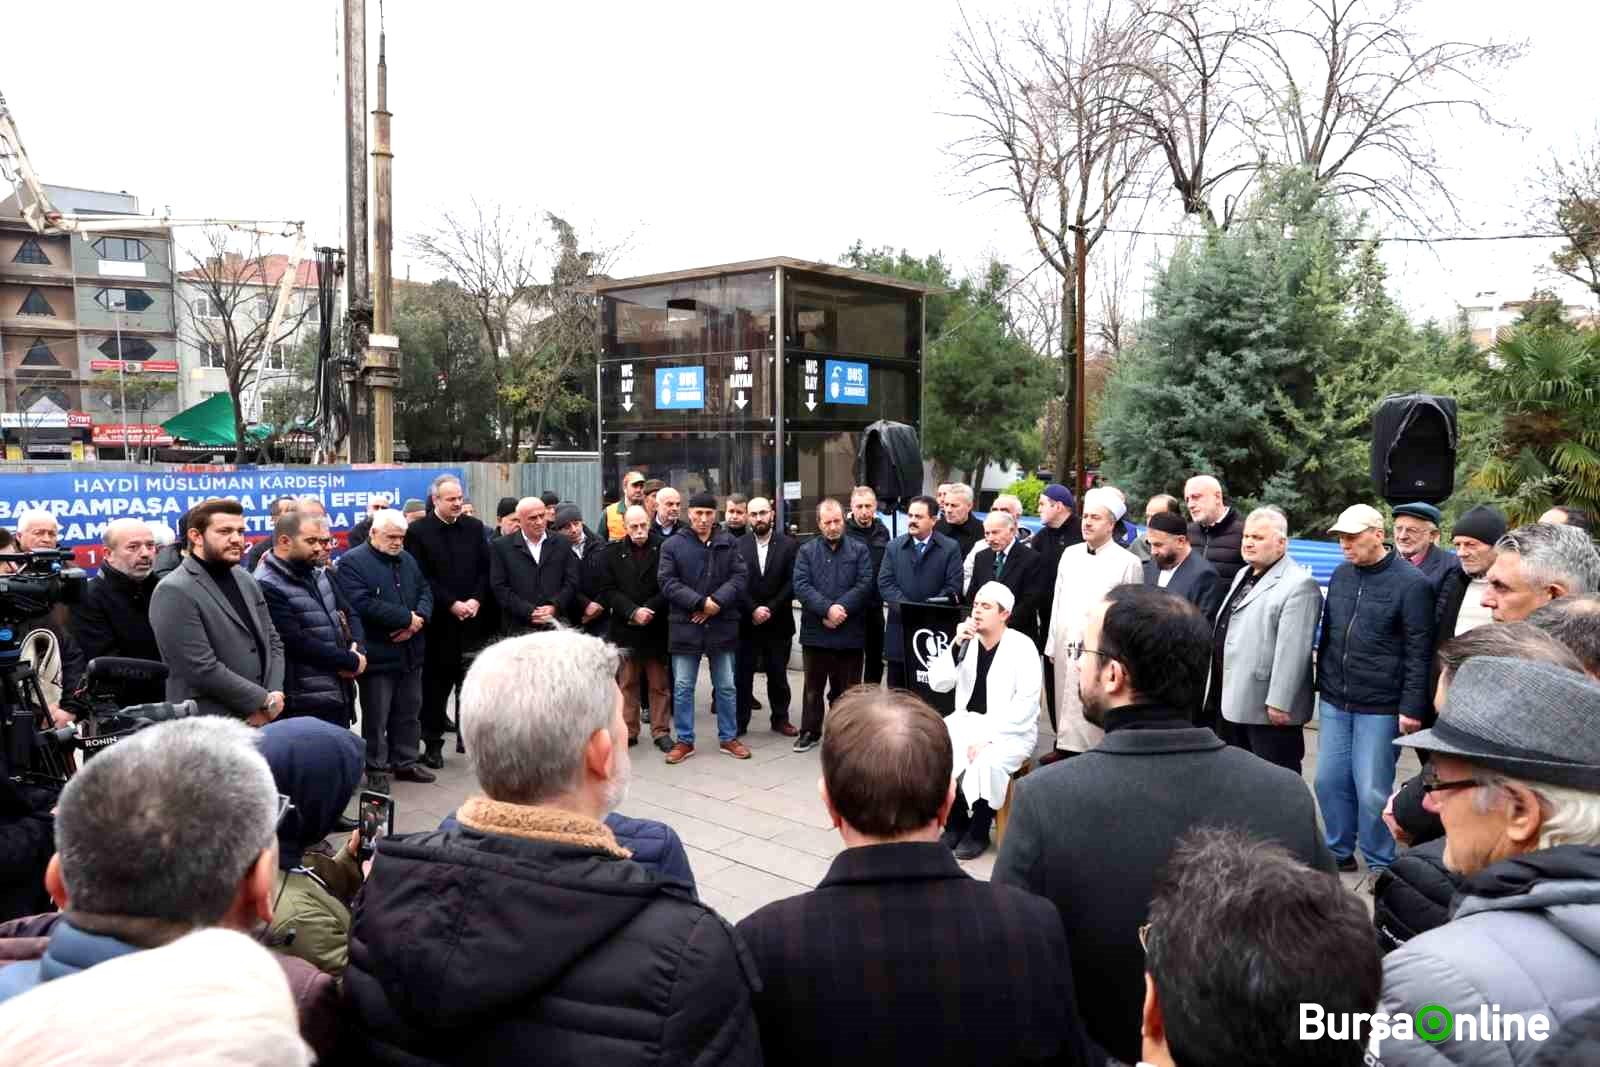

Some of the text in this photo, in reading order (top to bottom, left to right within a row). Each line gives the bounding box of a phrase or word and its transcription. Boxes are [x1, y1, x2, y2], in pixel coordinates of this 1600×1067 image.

[74, 473, 345, 493] HAYDİ MÜSLÜMAN KARDEŞİM
